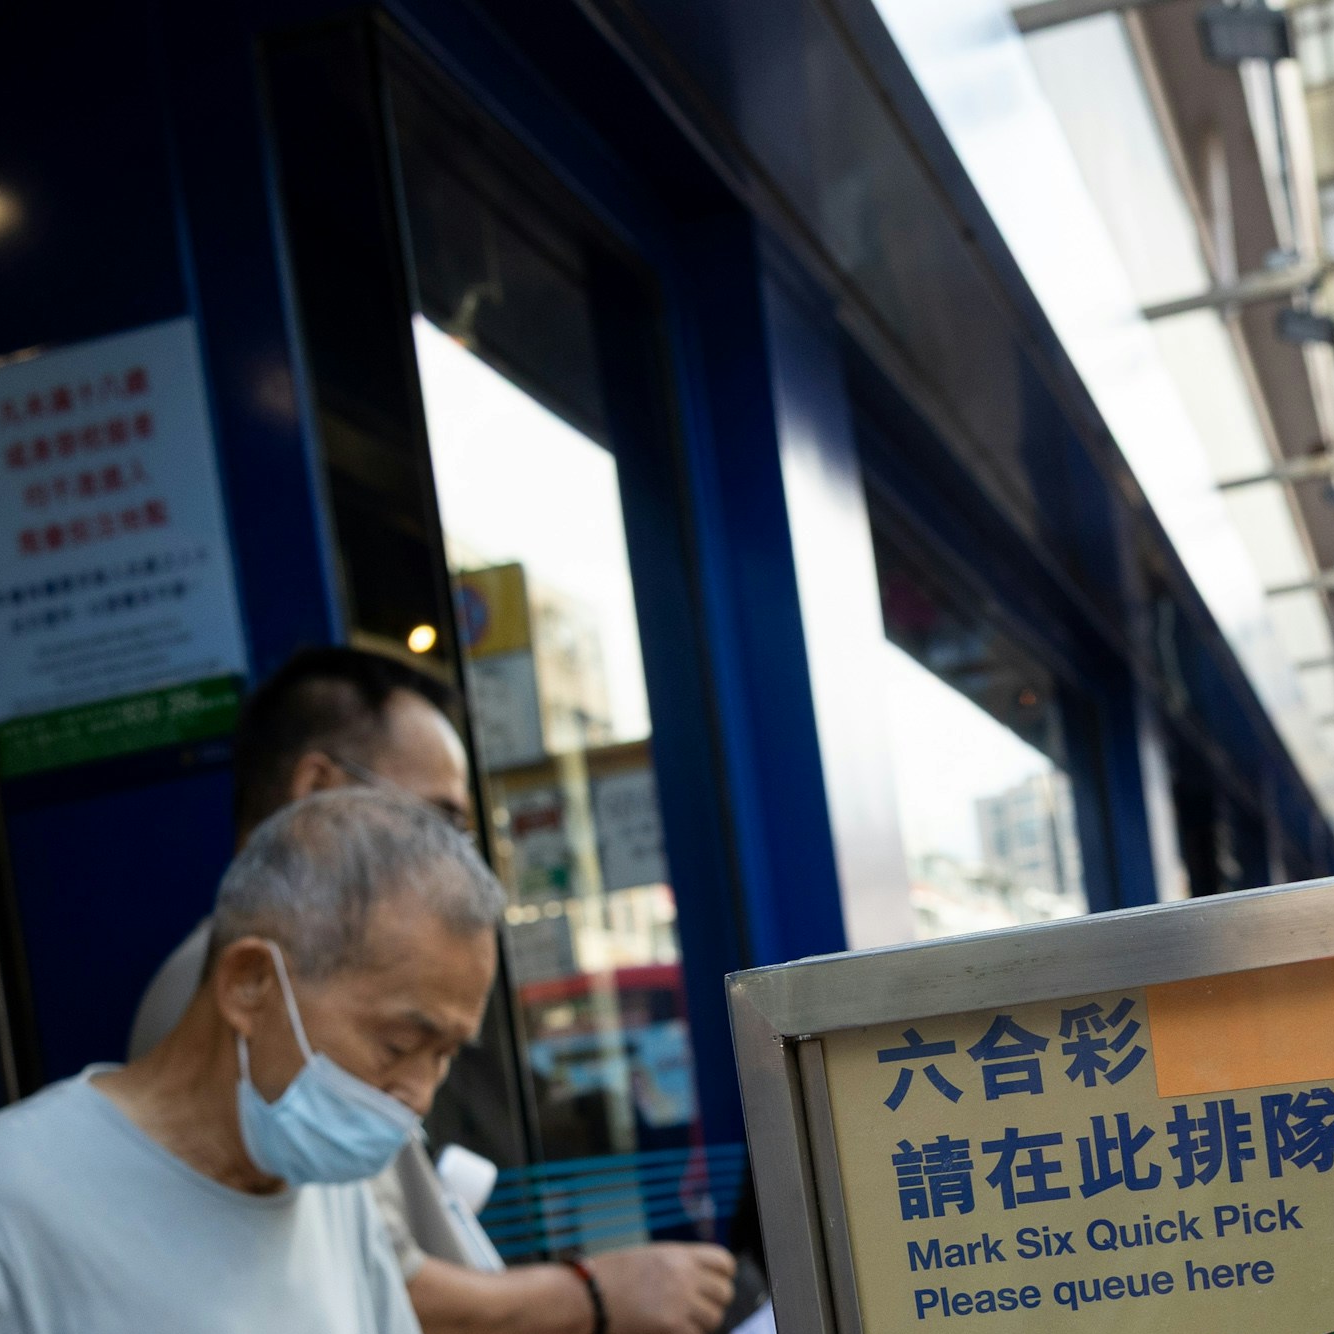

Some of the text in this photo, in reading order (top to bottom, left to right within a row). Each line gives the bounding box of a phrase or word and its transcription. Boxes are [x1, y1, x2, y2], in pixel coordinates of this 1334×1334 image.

[877, 998, 1147, 1112] 六合彩
[907, 1199, 1303, 1272] Mark Six Quick Pick
[914, 1260, 1275, 1319] Please queue here
